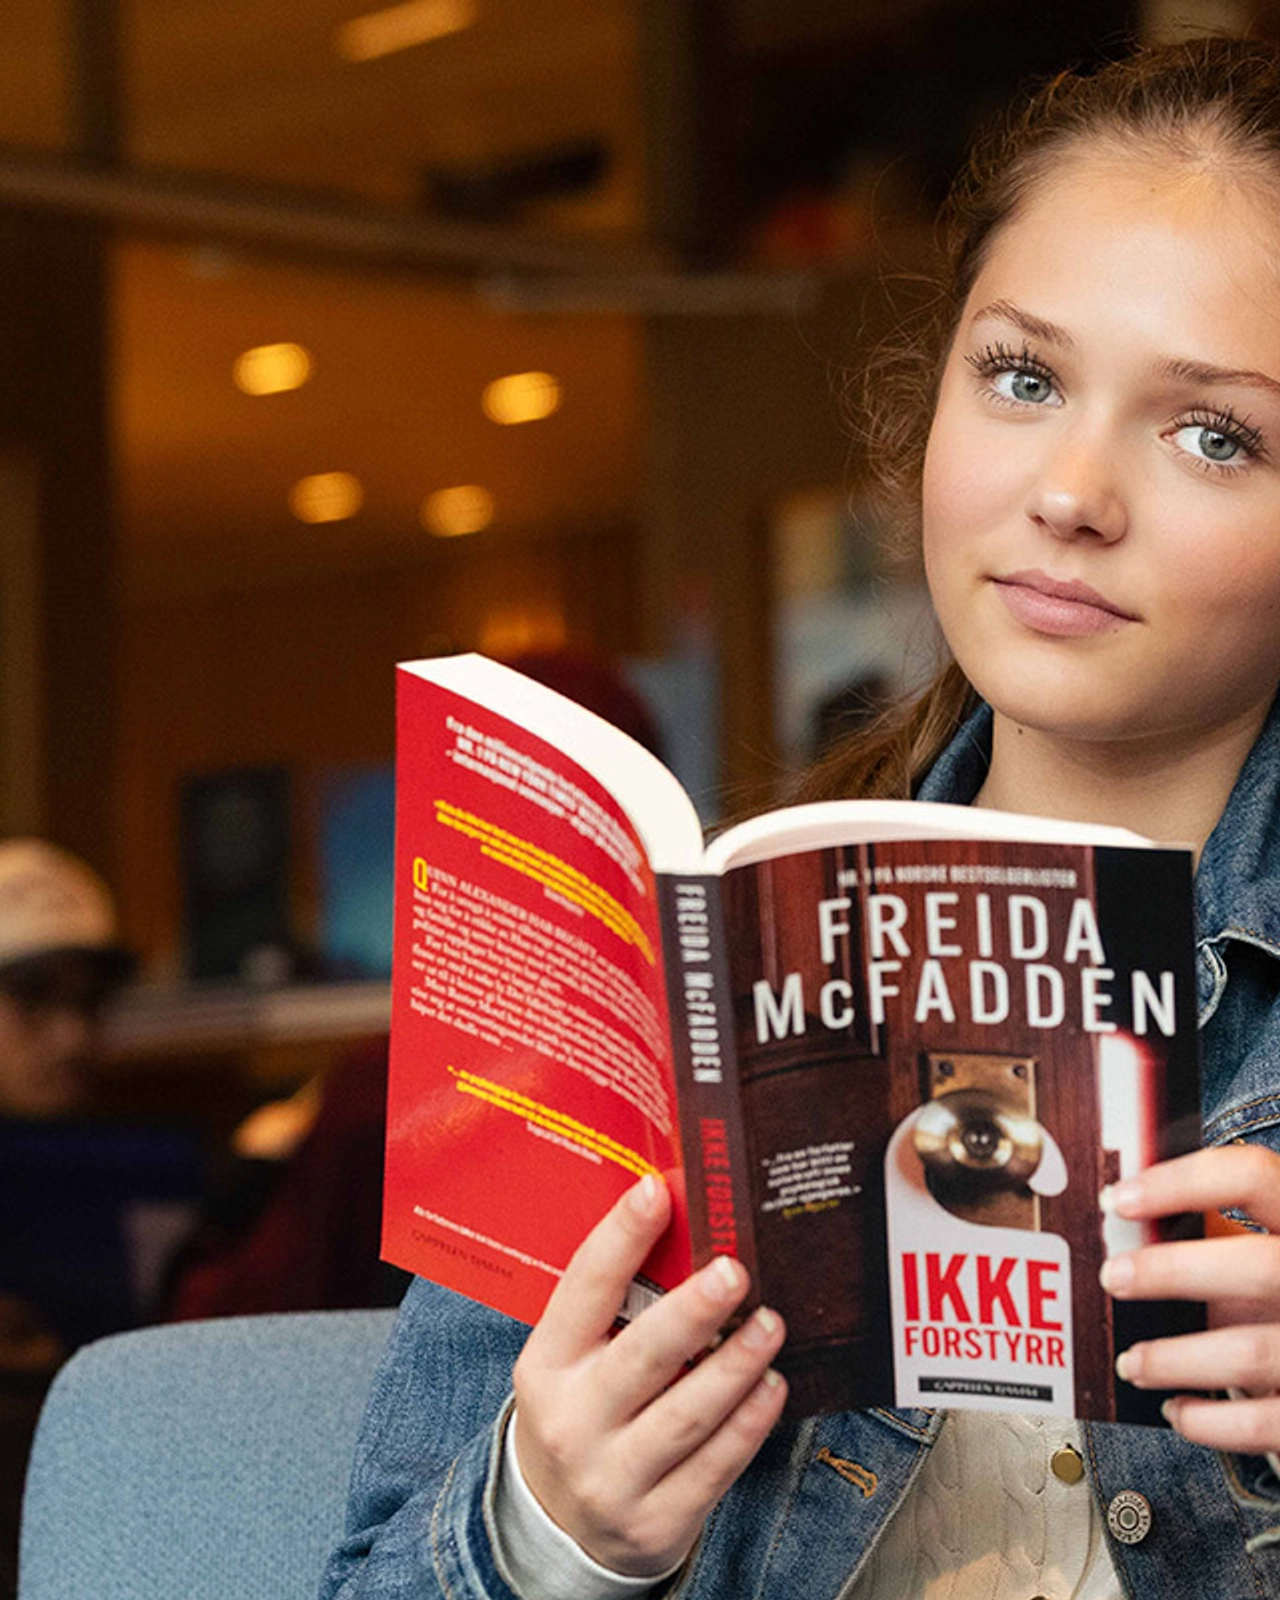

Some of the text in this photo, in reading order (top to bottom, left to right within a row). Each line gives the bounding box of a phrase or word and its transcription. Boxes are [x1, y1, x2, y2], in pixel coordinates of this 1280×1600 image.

[895, 864, 948, 884] NORSKE
[818, 892, 1106, 965] FREIDA
[674, 884, 723, 1084] FREIDA McFADDEN
[752, 958, 1176, 1045] McFADDEN
[699, 1117, 738, 1258] IKKE FORSTY
[901, 1252, 1064, 1332] IKKE
[904, 1326, 1066, 1368] FORSTYRR
